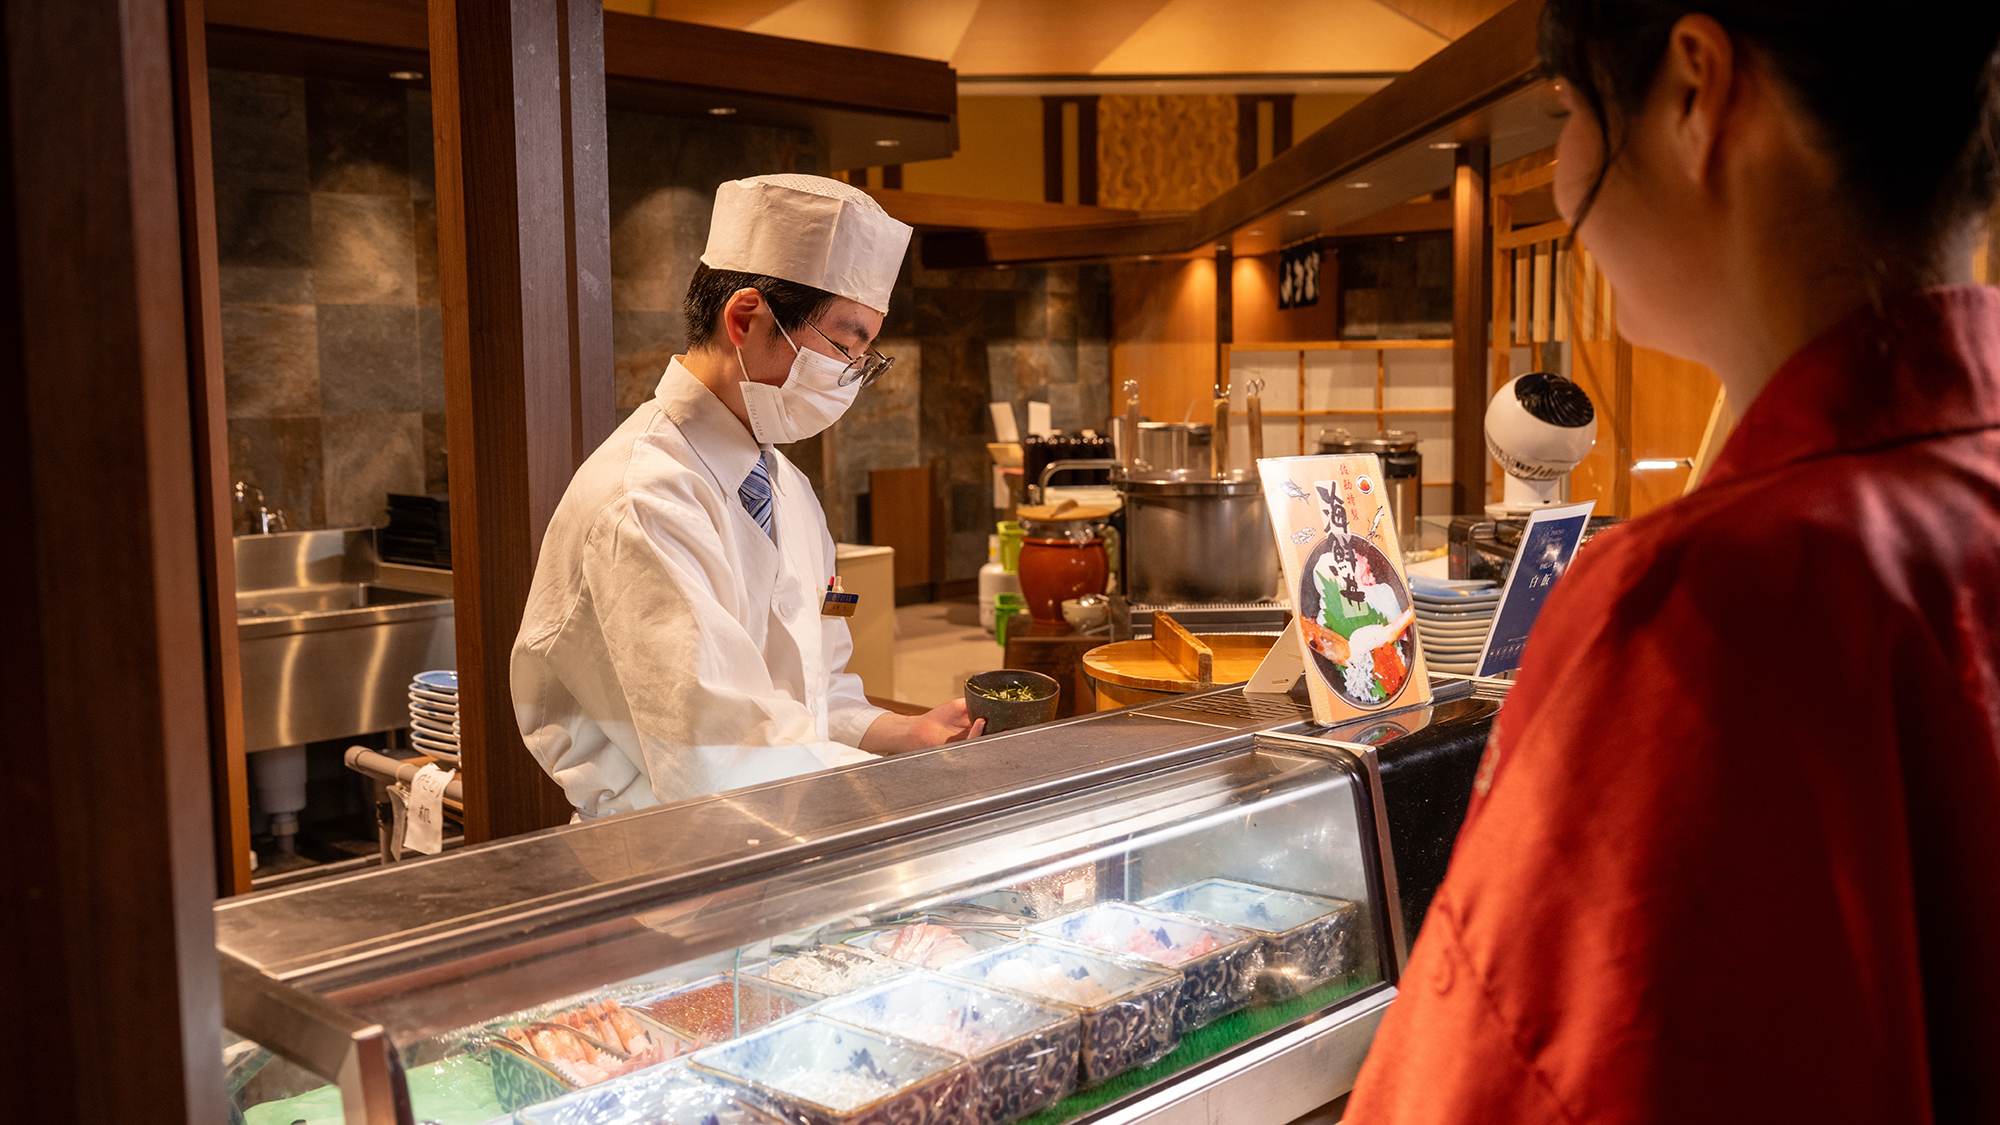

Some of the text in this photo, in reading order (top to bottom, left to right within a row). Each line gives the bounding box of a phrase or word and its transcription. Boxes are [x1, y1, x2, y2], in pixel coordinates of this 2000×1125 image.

[1339, 462, 1360, 522] 佐助特製
[1315, 480, 1366, 612] 海鮮丼
[1528, 572, 1553, 589] 白飯
